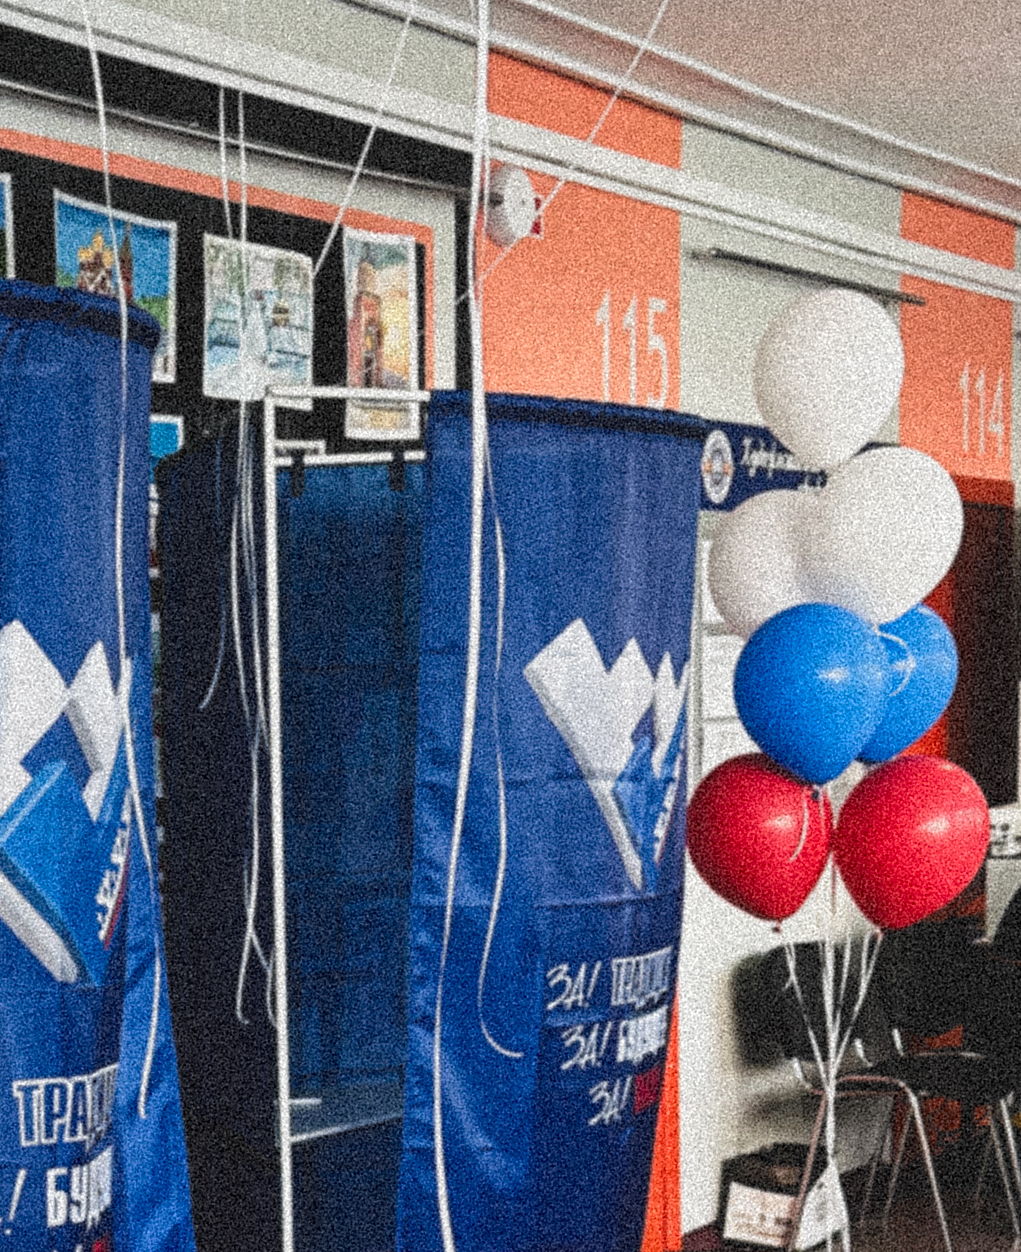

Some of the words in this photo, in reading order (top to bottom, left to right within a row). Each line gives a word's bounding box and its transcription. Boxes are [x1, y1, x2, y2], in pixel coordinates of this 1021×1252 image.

[595, 288, 669, 410] 115
[959, 361, 1004, 458] 114
[545, 960, 603, 1011] ЗА!
[560, 1020, 613, 1071] ЗА!
[588, 1073, 634, 1127] ЗА!
